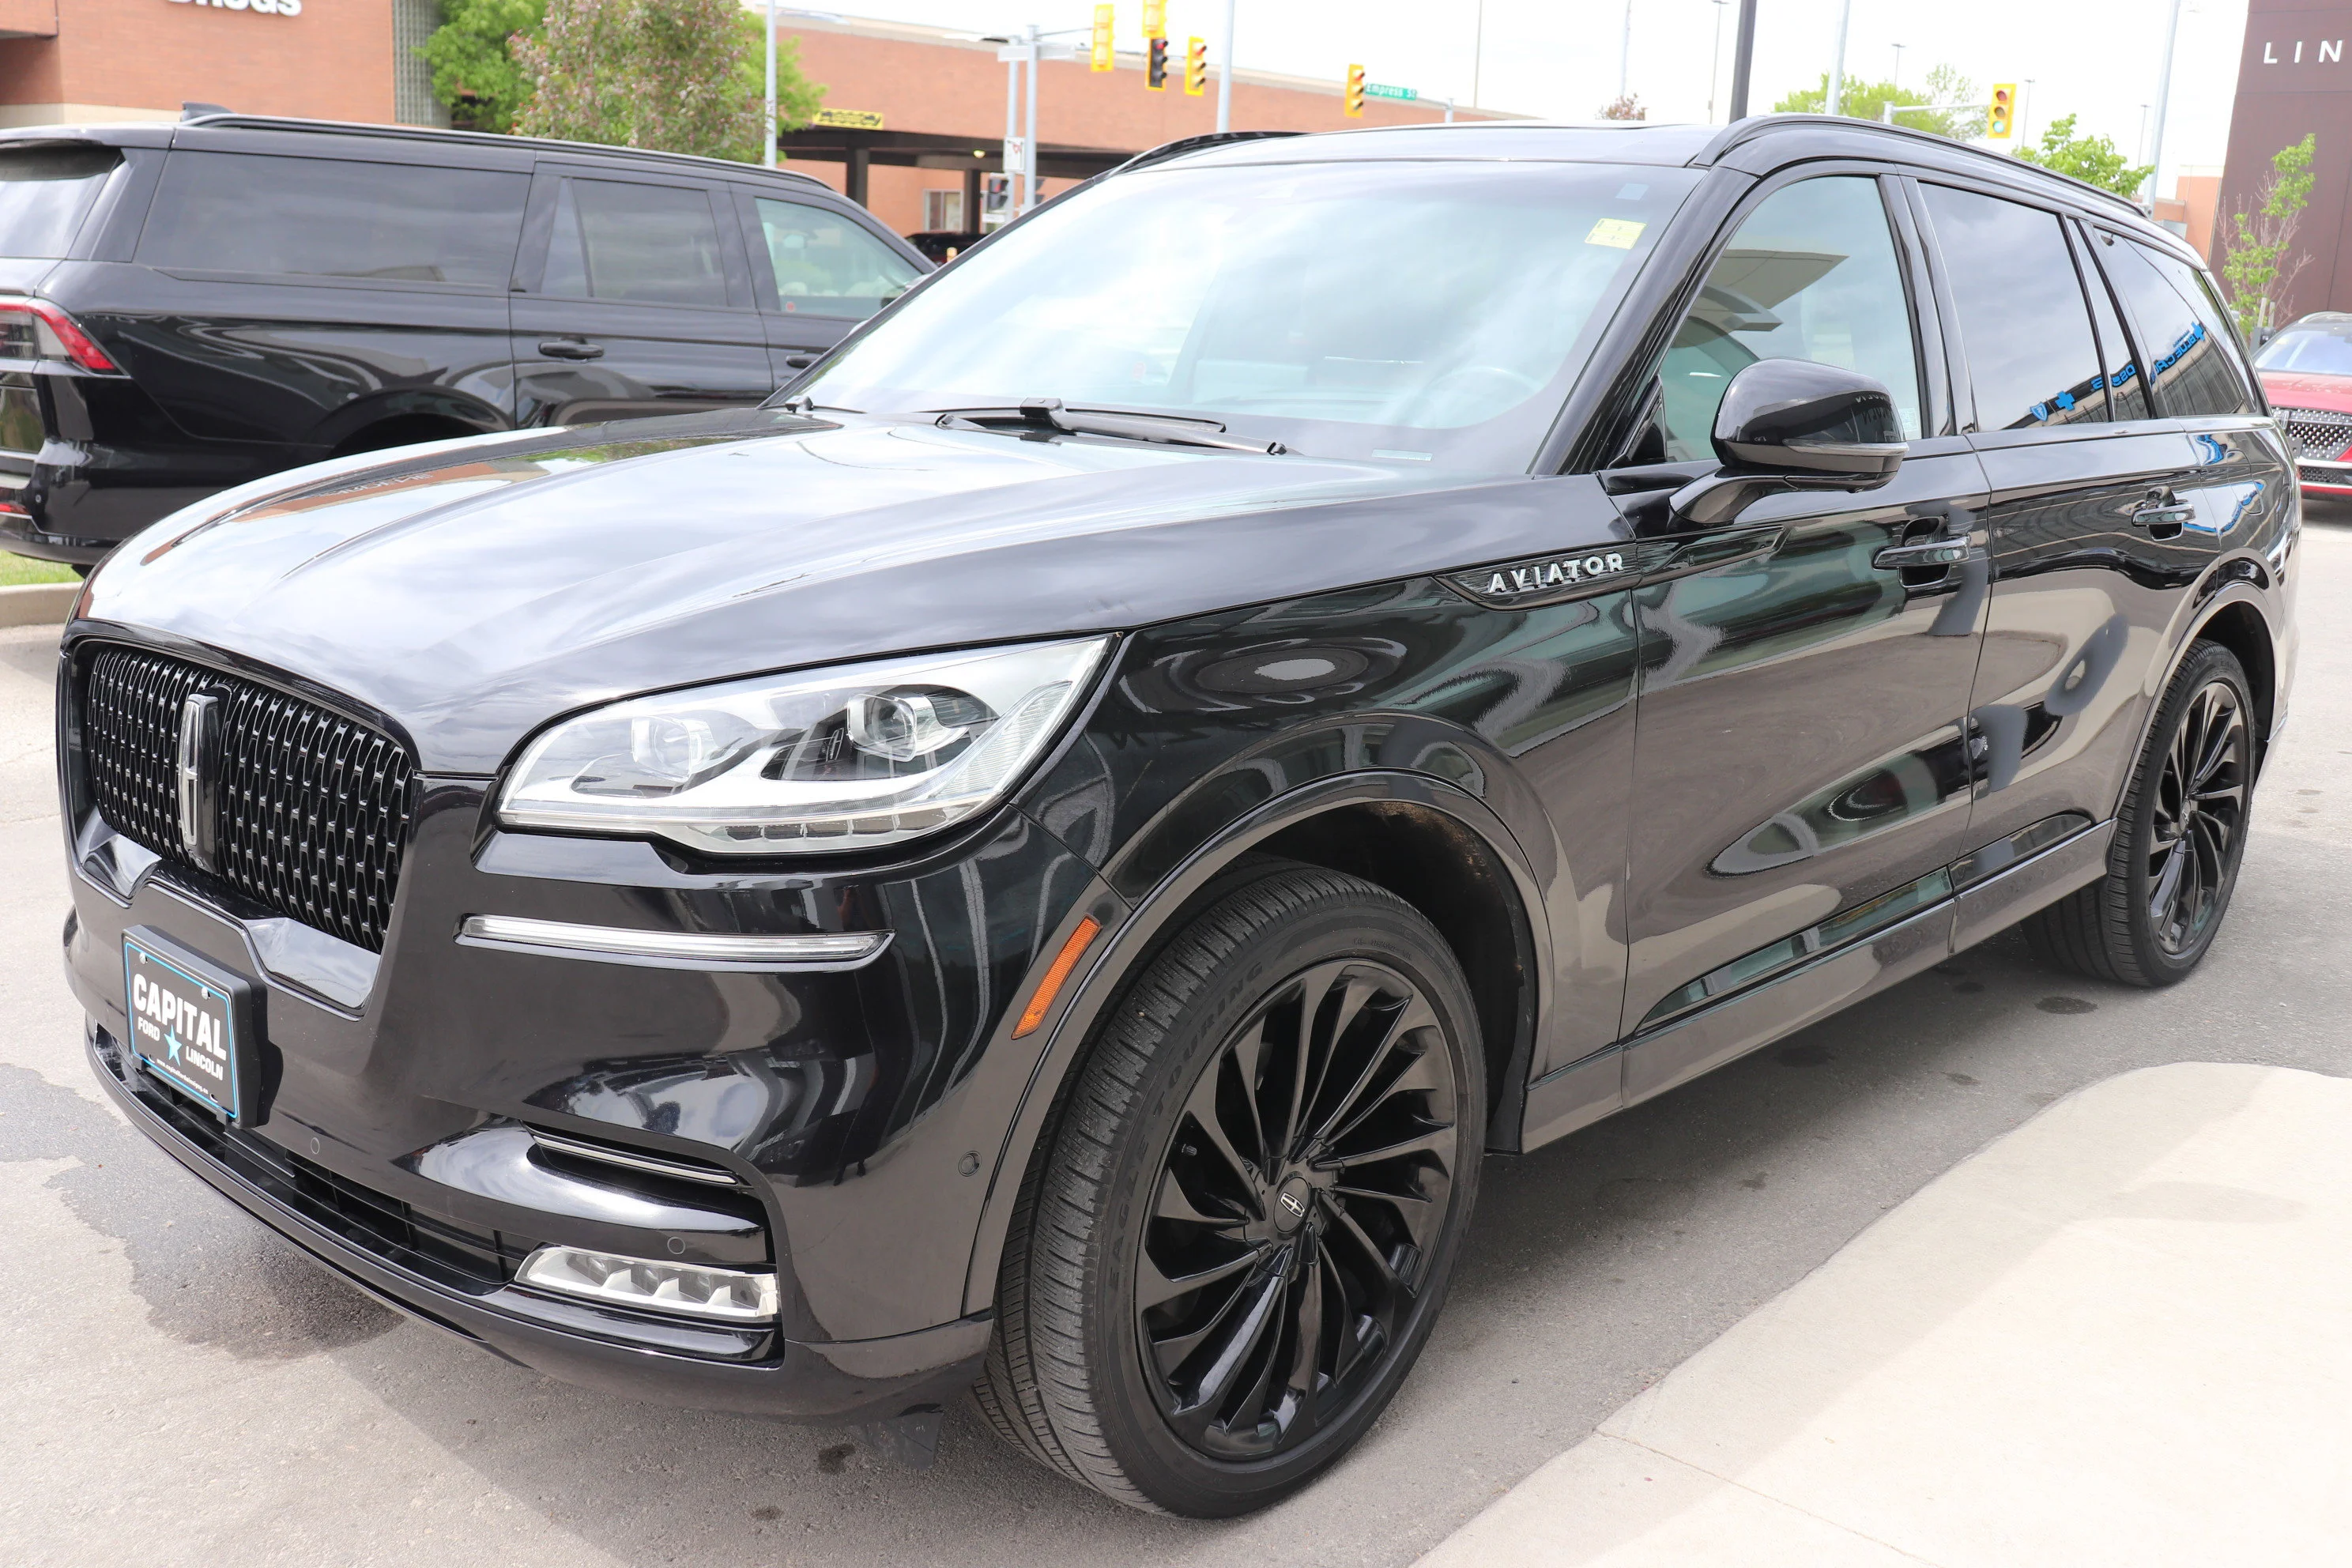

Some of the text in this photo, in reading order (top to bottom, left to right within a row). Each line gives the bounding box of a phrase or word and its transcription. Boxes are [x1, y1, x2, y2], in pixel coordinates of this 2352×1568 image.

[2263, 40, 2343, 64] LIN
[1366, 83, 1404, 96] Empress
[1487, 552, 1624, 594] AVIATOR
[133, 973, 227, 1061] CAPITAL
[138, 1016, 160, 1042] FORD
[1153, 961, 1263, 1119] TOURING
[186, 1046, 224, 1081] LINCOLN
